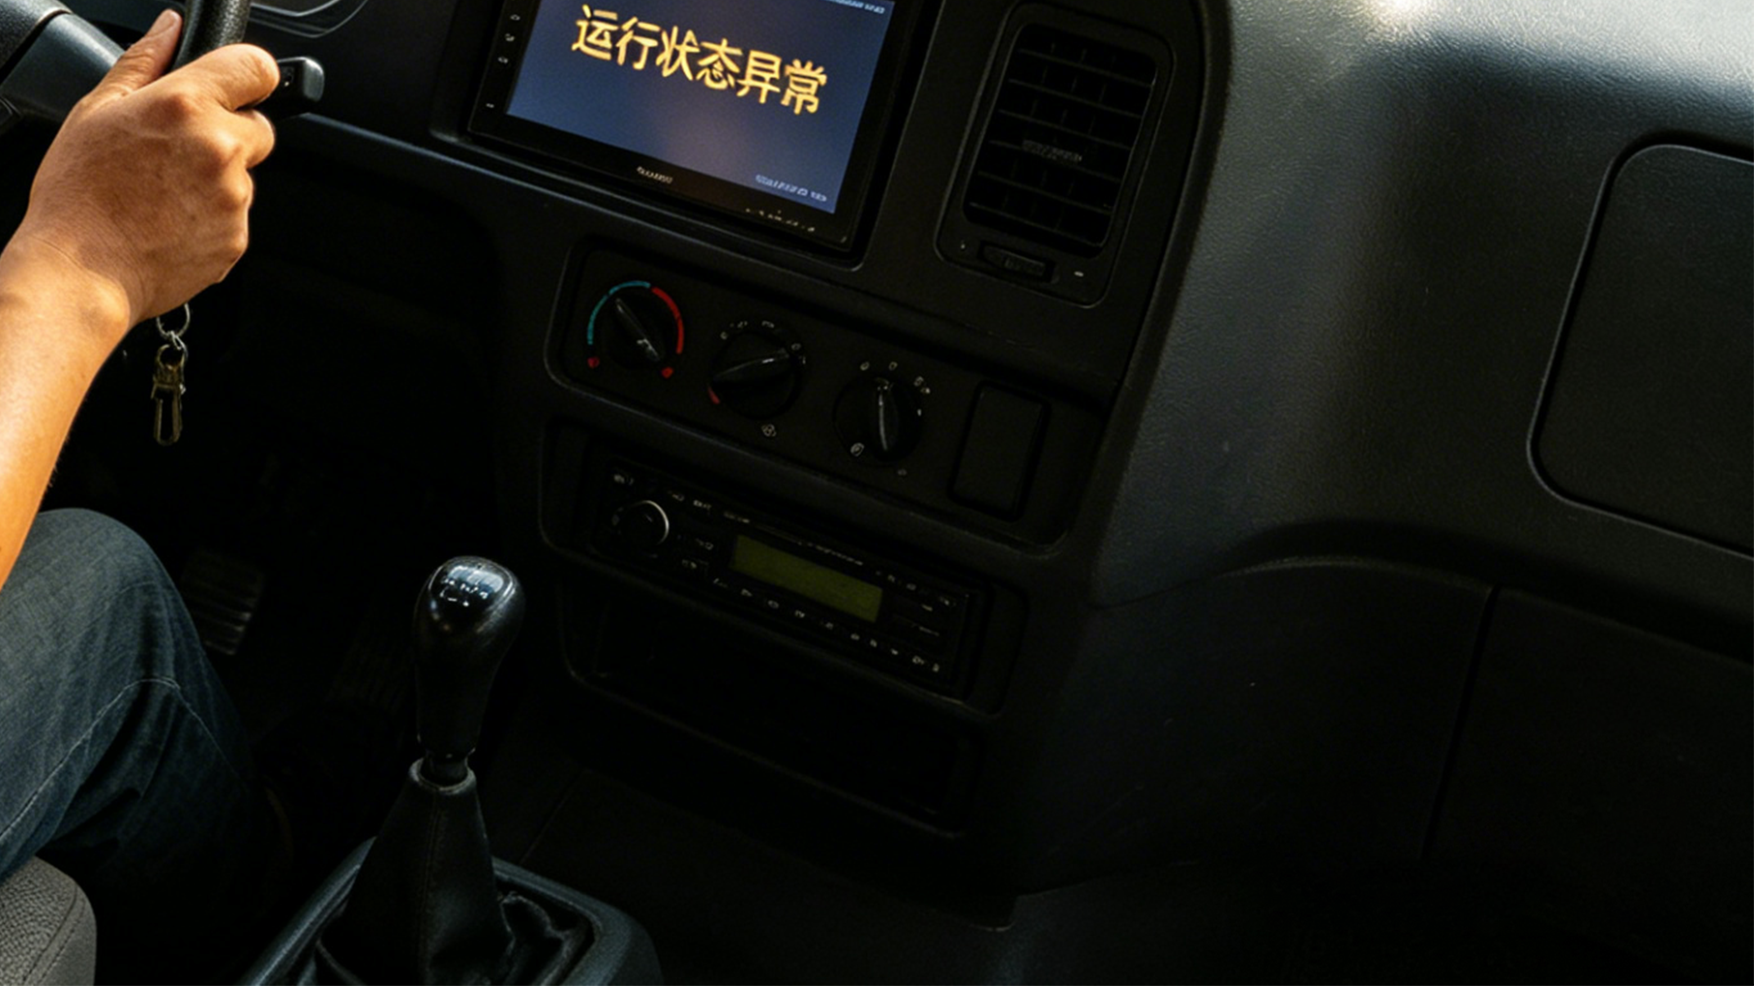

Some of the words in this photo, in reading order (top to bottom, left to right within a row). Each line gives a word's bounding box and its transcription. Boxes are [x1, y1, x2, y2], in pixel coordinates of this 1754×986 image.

[571, 3, 828, 115] 运行状态异常
